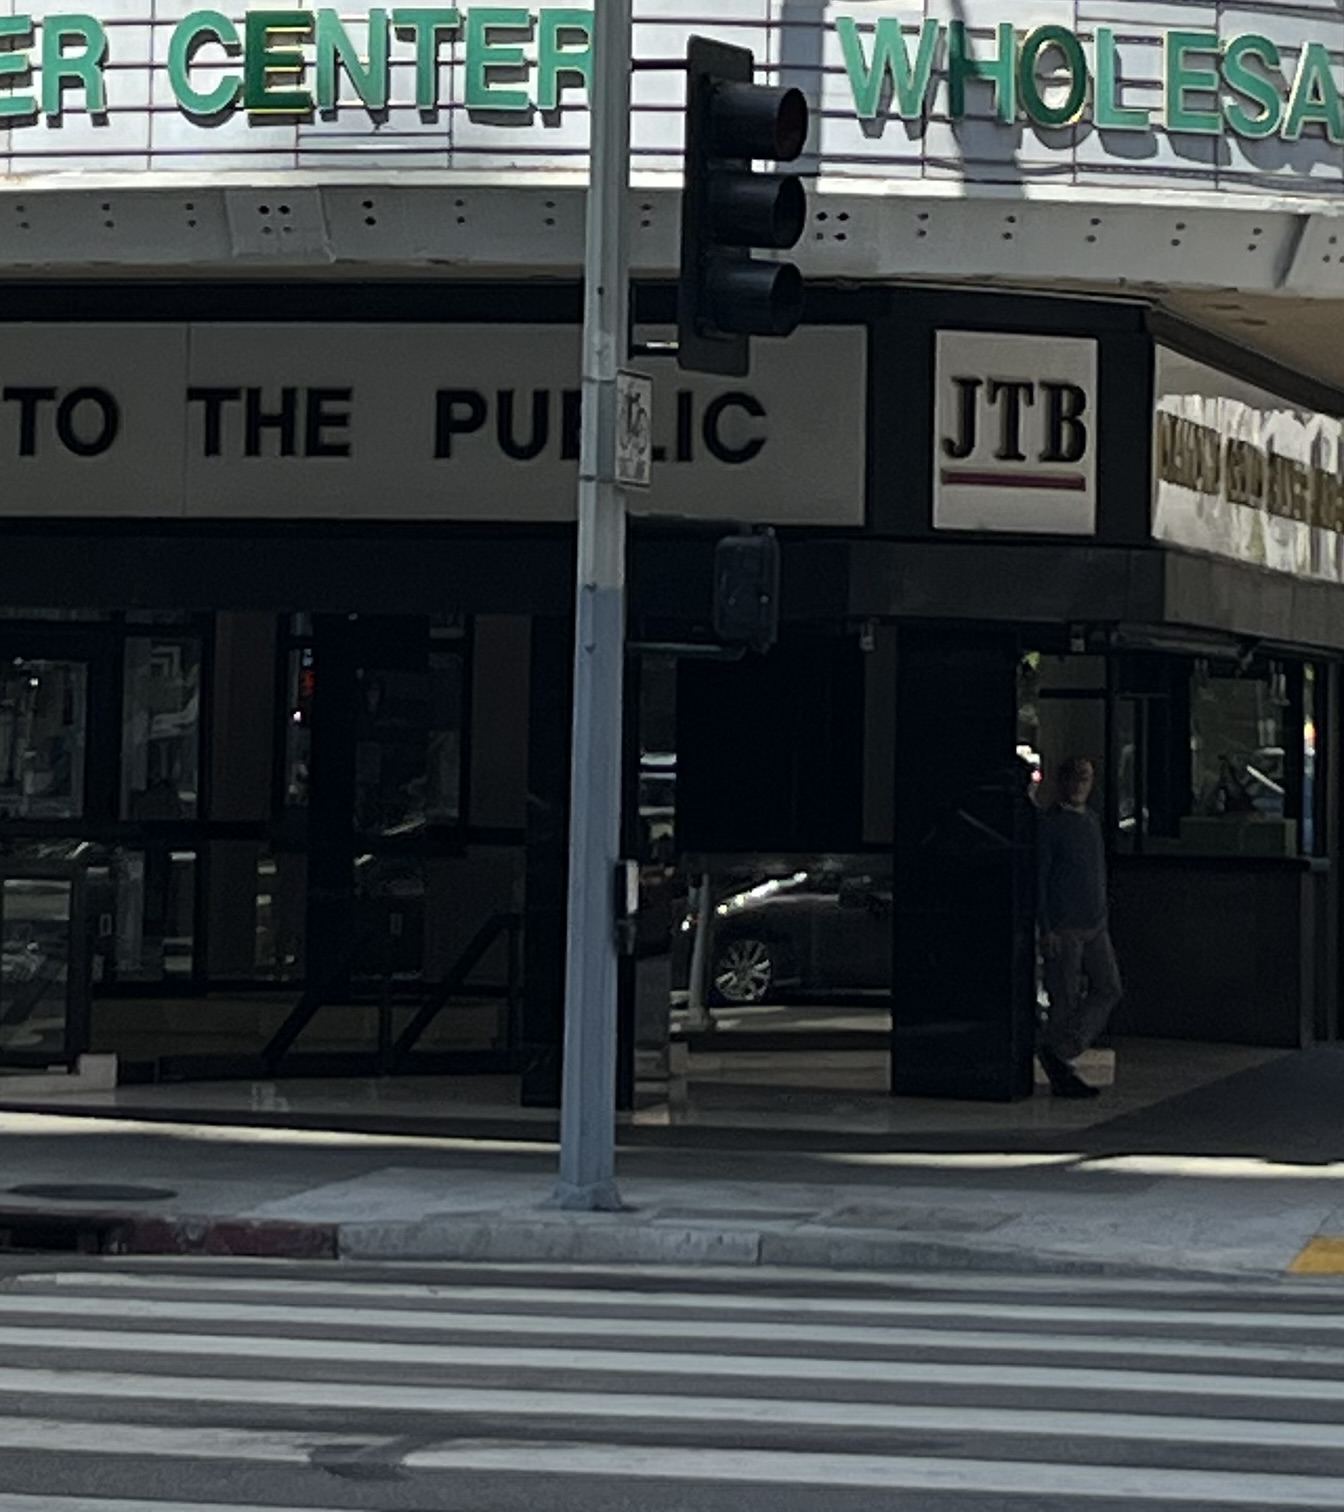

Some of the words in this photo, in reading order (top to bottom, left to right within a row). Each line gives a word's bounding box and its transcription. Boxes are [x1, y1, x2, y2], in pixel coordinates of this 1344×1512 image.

[167, 7, 594, 114] CENTER
[2, 386, 119, 457] TO
[187, 386, 352, 457] THE
[433, 390, 768, 465] PUIC
[941, 375, 1088, 463] JTB
